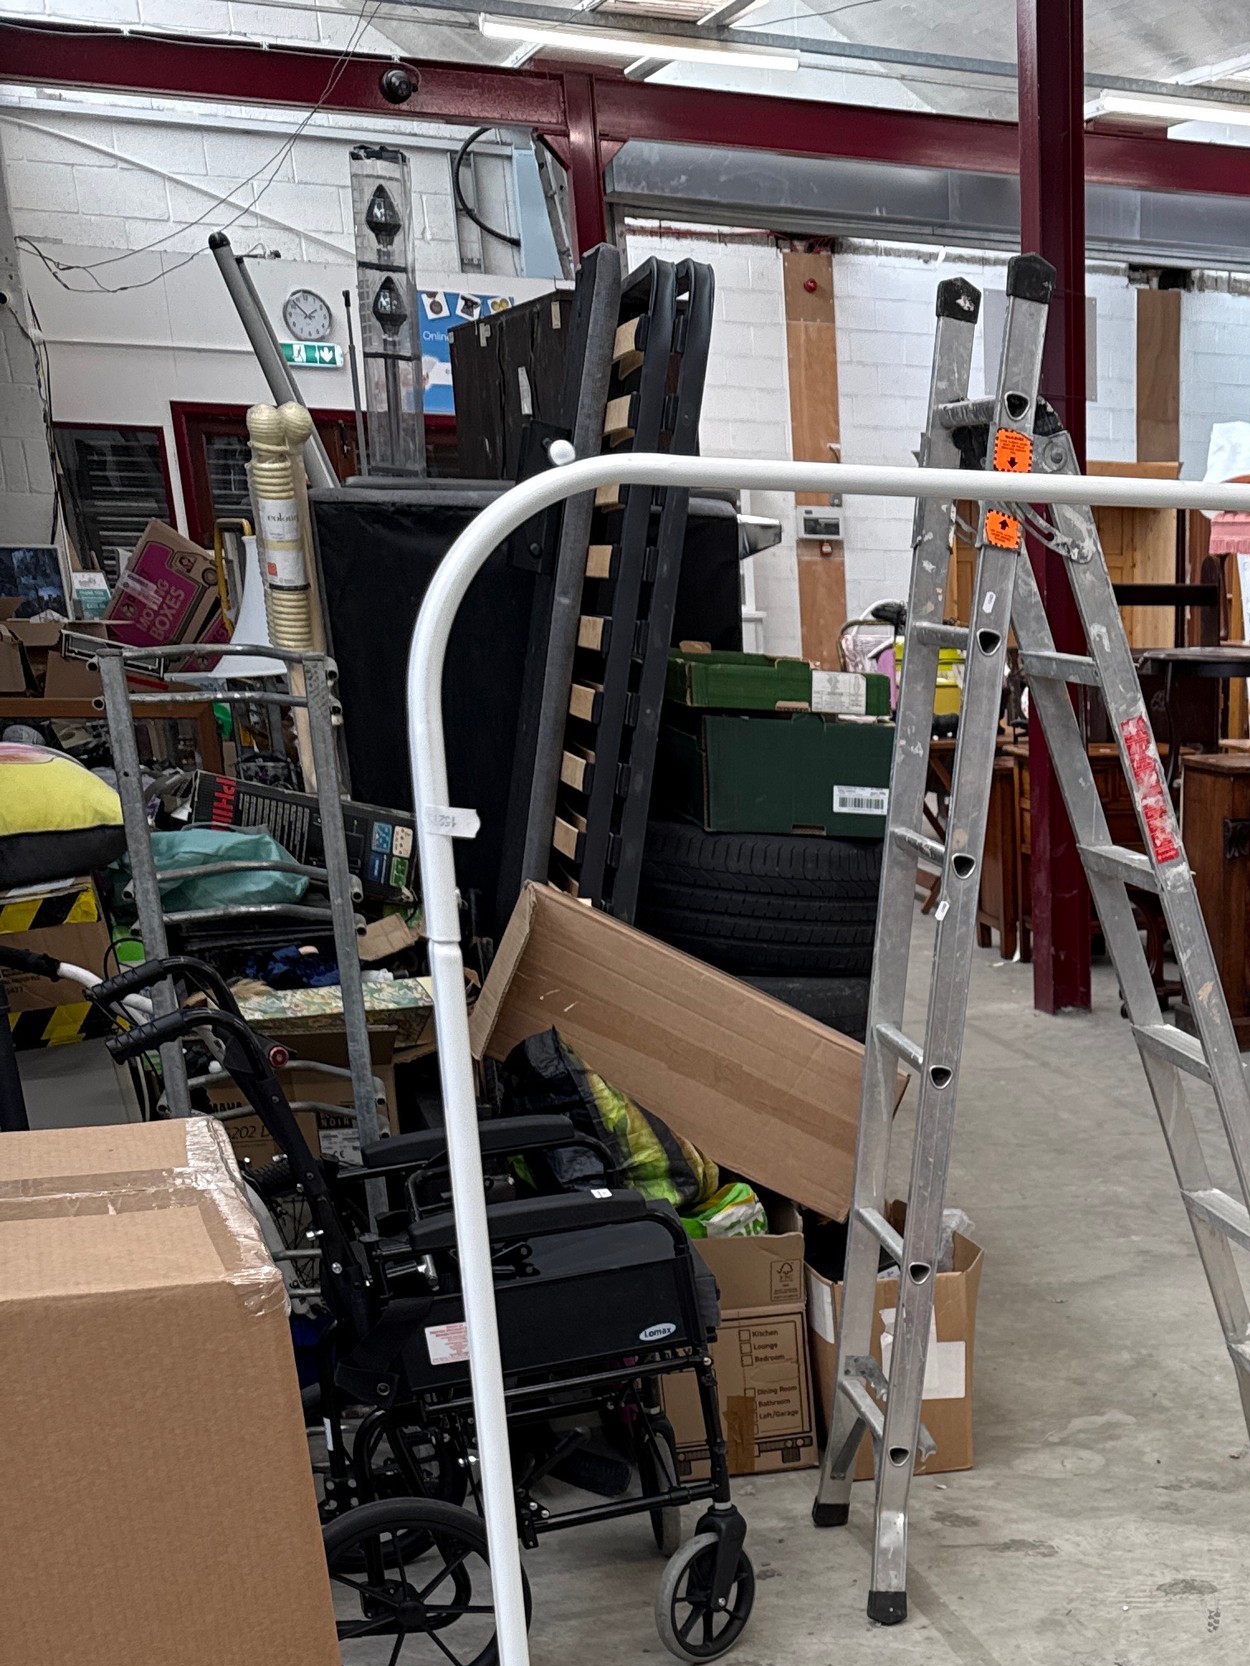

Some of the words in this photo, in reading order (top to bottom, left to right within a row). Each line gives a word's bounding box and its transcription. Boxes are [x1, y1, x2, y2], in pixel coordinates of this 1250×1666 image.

[135, 578, 170, 632] MONG
[150, 586, 185, 641] BOXES
[643, 1325, 673, 1340] Lomax
[751, 1328, 779, 1338] Kitchen
[752, 1341, 779, 1352] Lounge
[754, 1353, 785, 1363] Bedroom
[757, 1386, 779, 1396] Dining
[779, 1384, 798, 1394] Room
[757, 1397, 791, 1408] Bathroom
